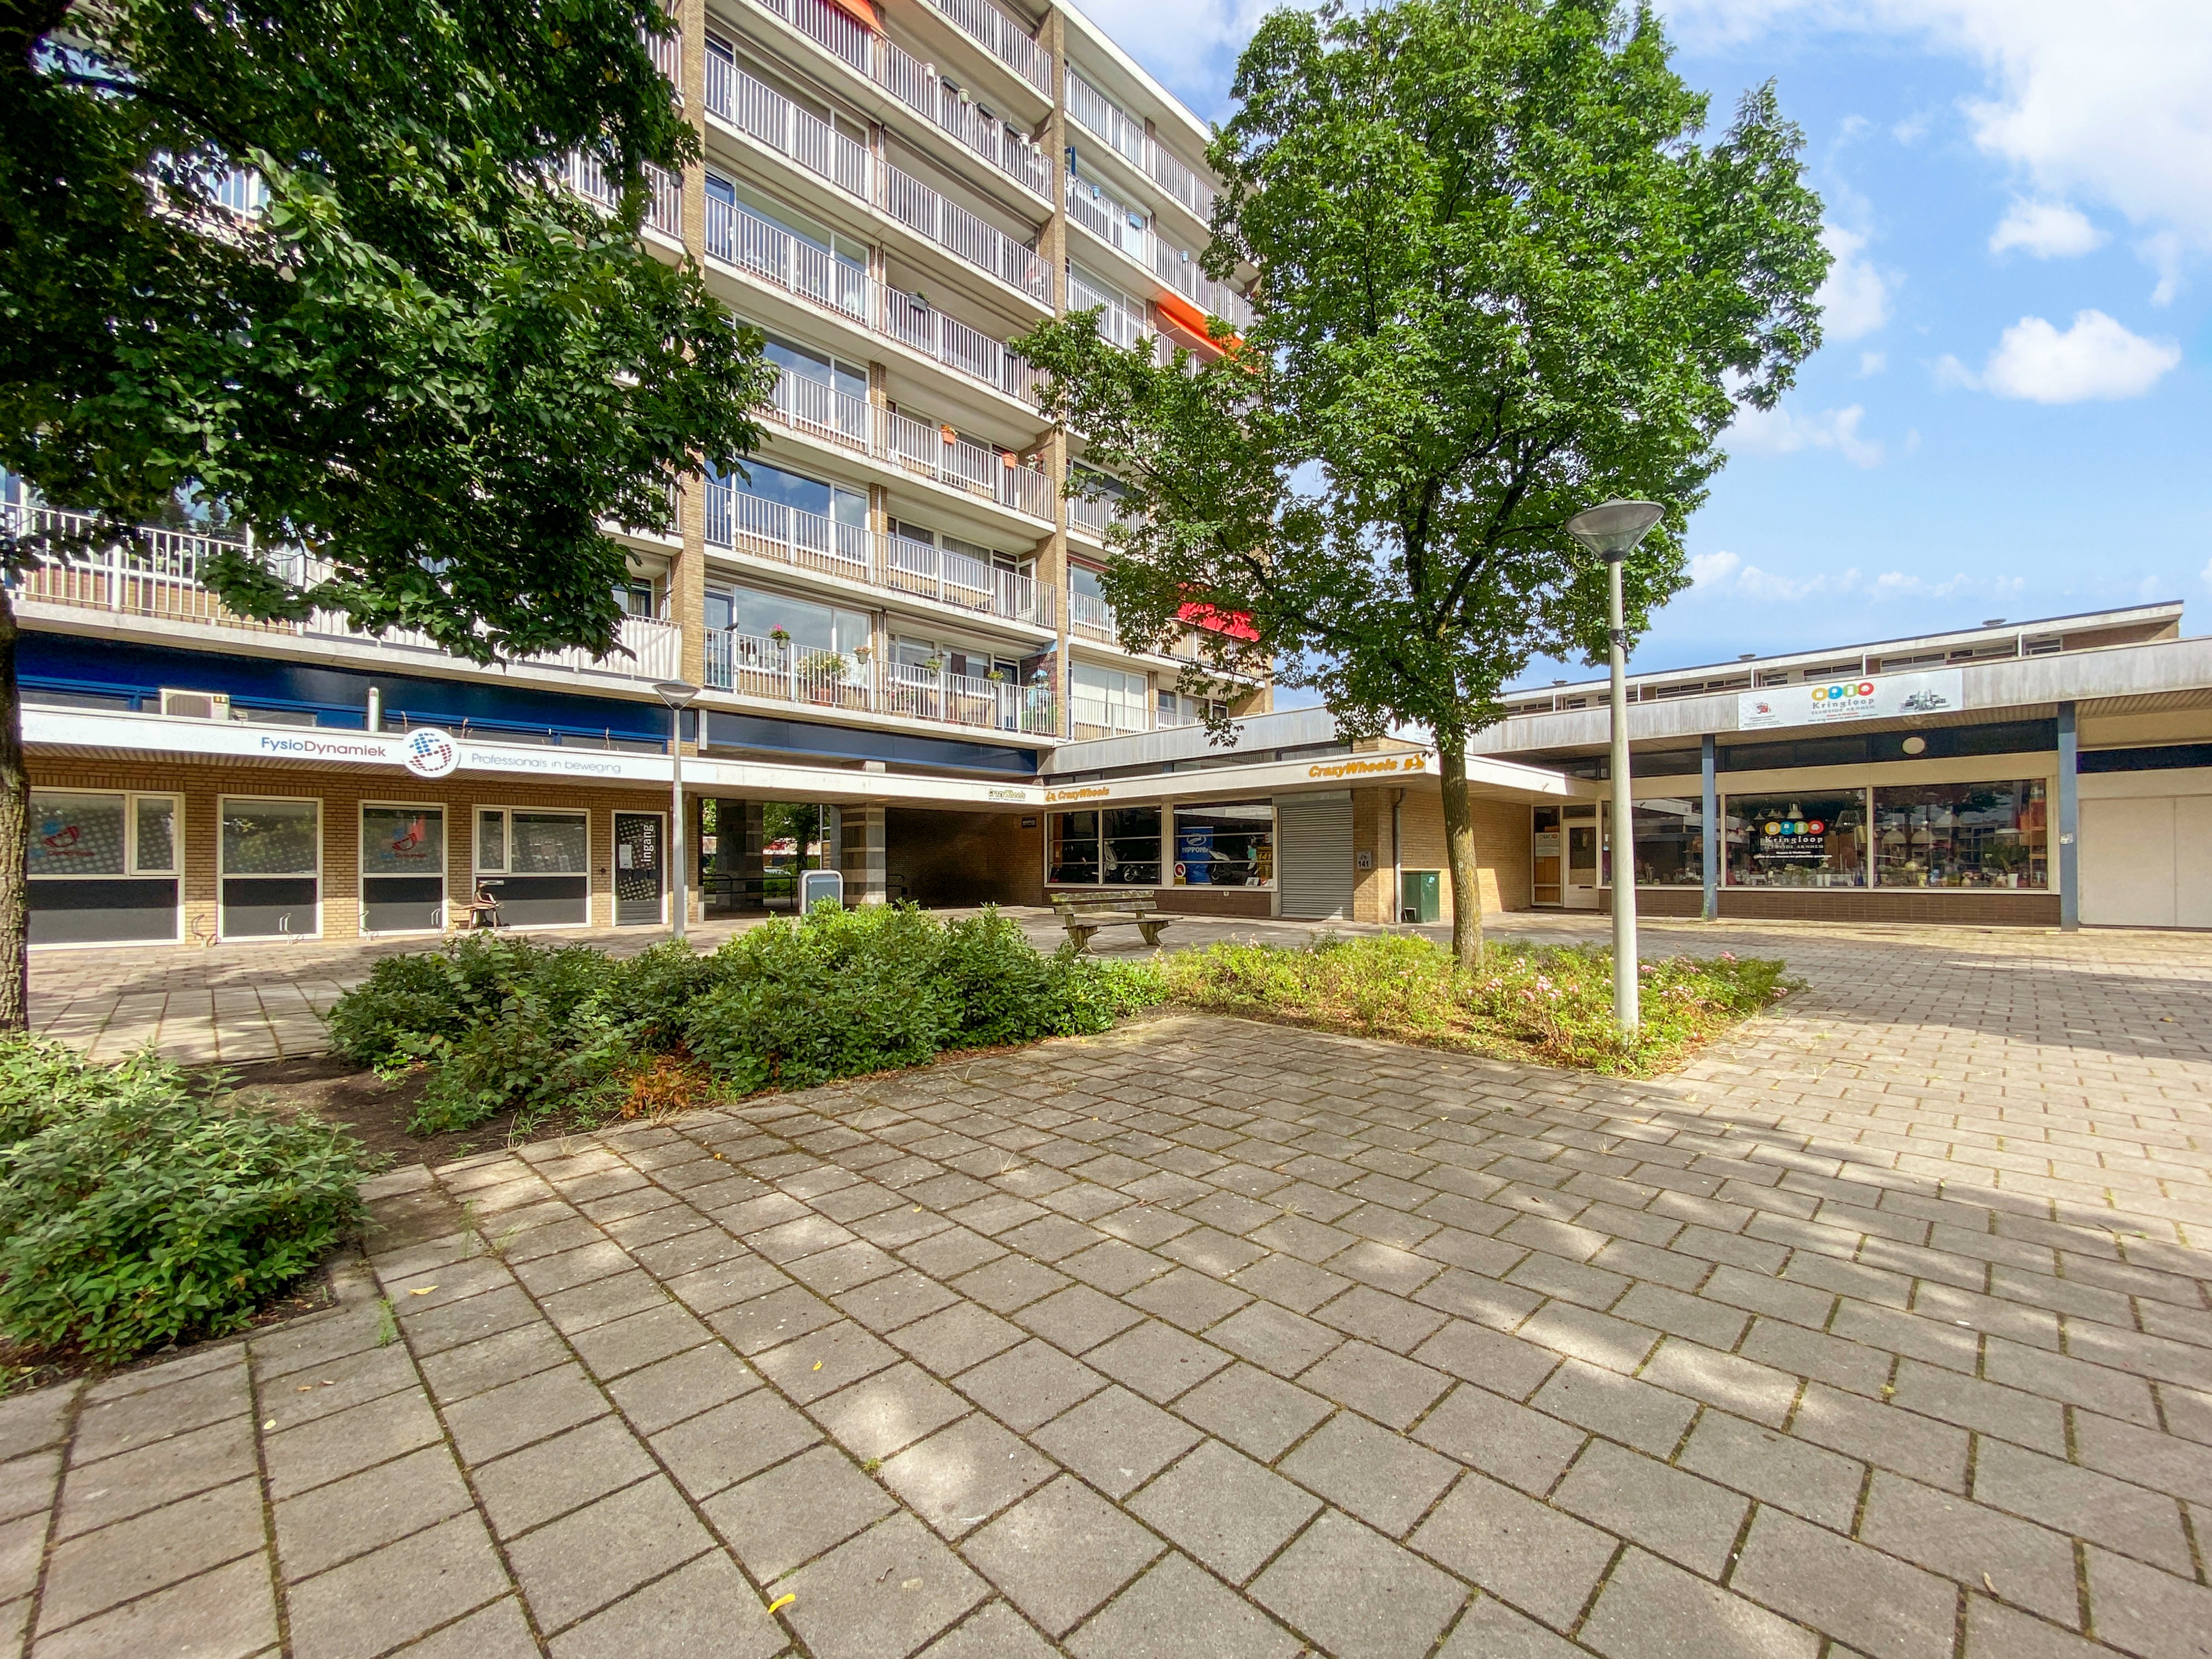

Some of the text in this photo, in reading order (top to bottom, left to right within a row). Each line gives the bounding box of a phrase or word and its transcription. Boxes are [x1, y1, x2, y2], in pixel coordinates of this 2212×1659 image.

[1813, 698, 1875, 709] Kringloop
[261, 737, 386, 757] FysioDynamiek
[471, 753, 548, 768] Professionals
[565, 760, 621, 774] beweging
[1309, 758, 1398, 778] CrazyWheels
[988, 788, 1026, 799] CrazyWheels
[1058, 787, 1109, 800] CrazyWheels
[640, 824, 654, 862] ingang
[1764, 836, 1823, 844] Kringloop
